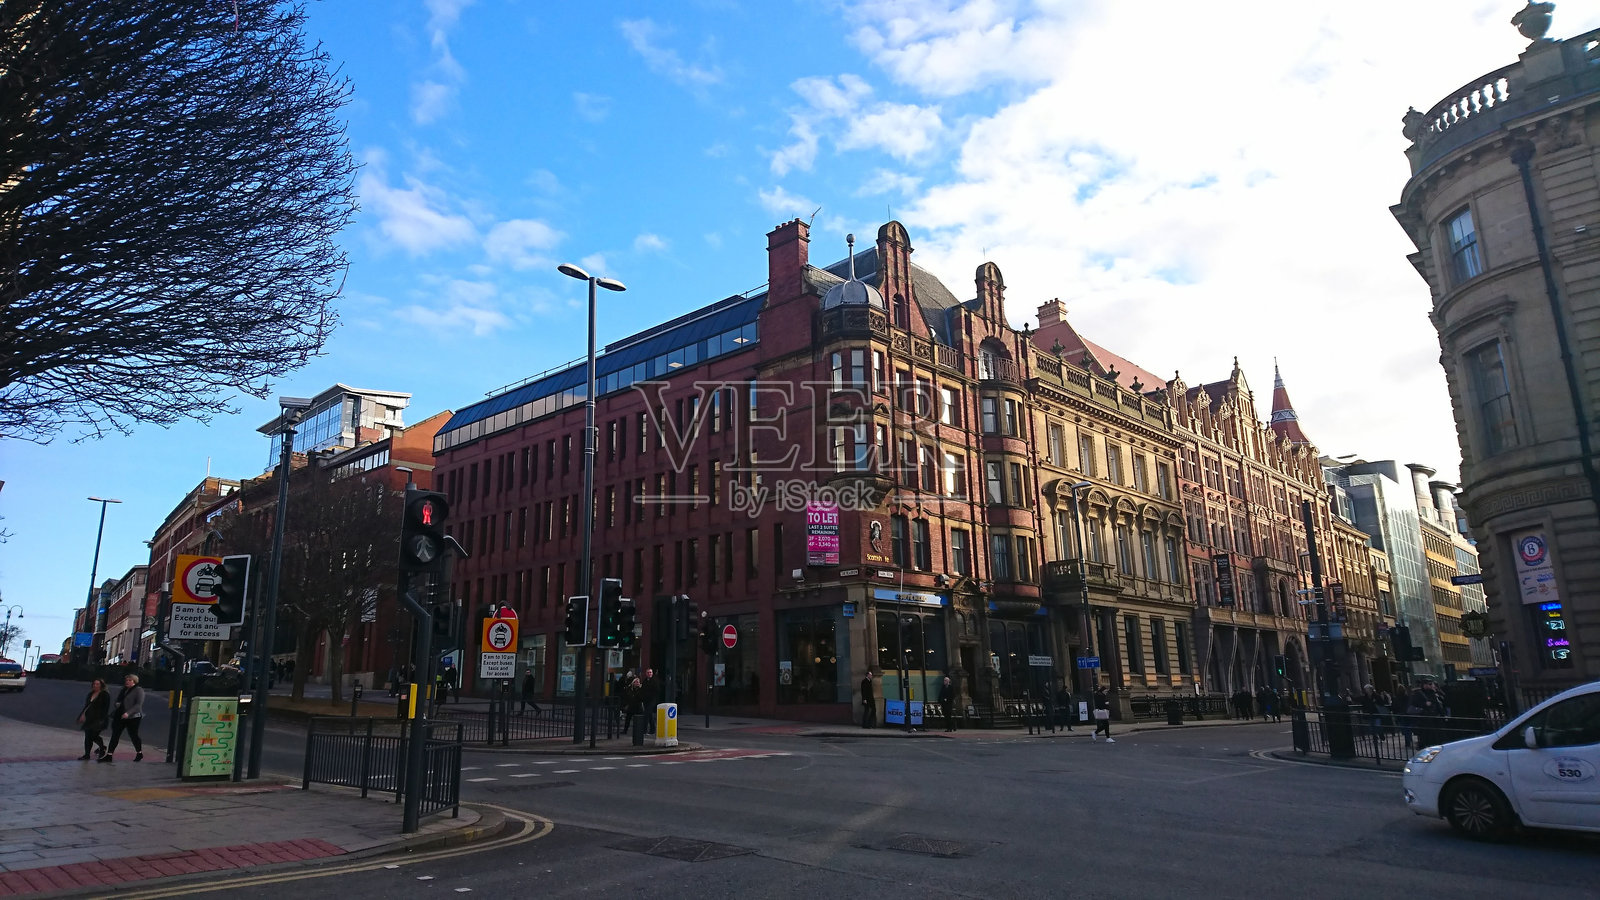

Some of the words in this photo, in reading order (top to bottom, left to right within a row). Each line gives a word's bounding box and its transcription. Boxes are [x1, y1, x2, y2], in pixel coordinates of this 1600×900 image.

[808, 512, 820, 523] TO
[822, 512, 838, 523] LET
[1558, 769, 1582, 778] 530
